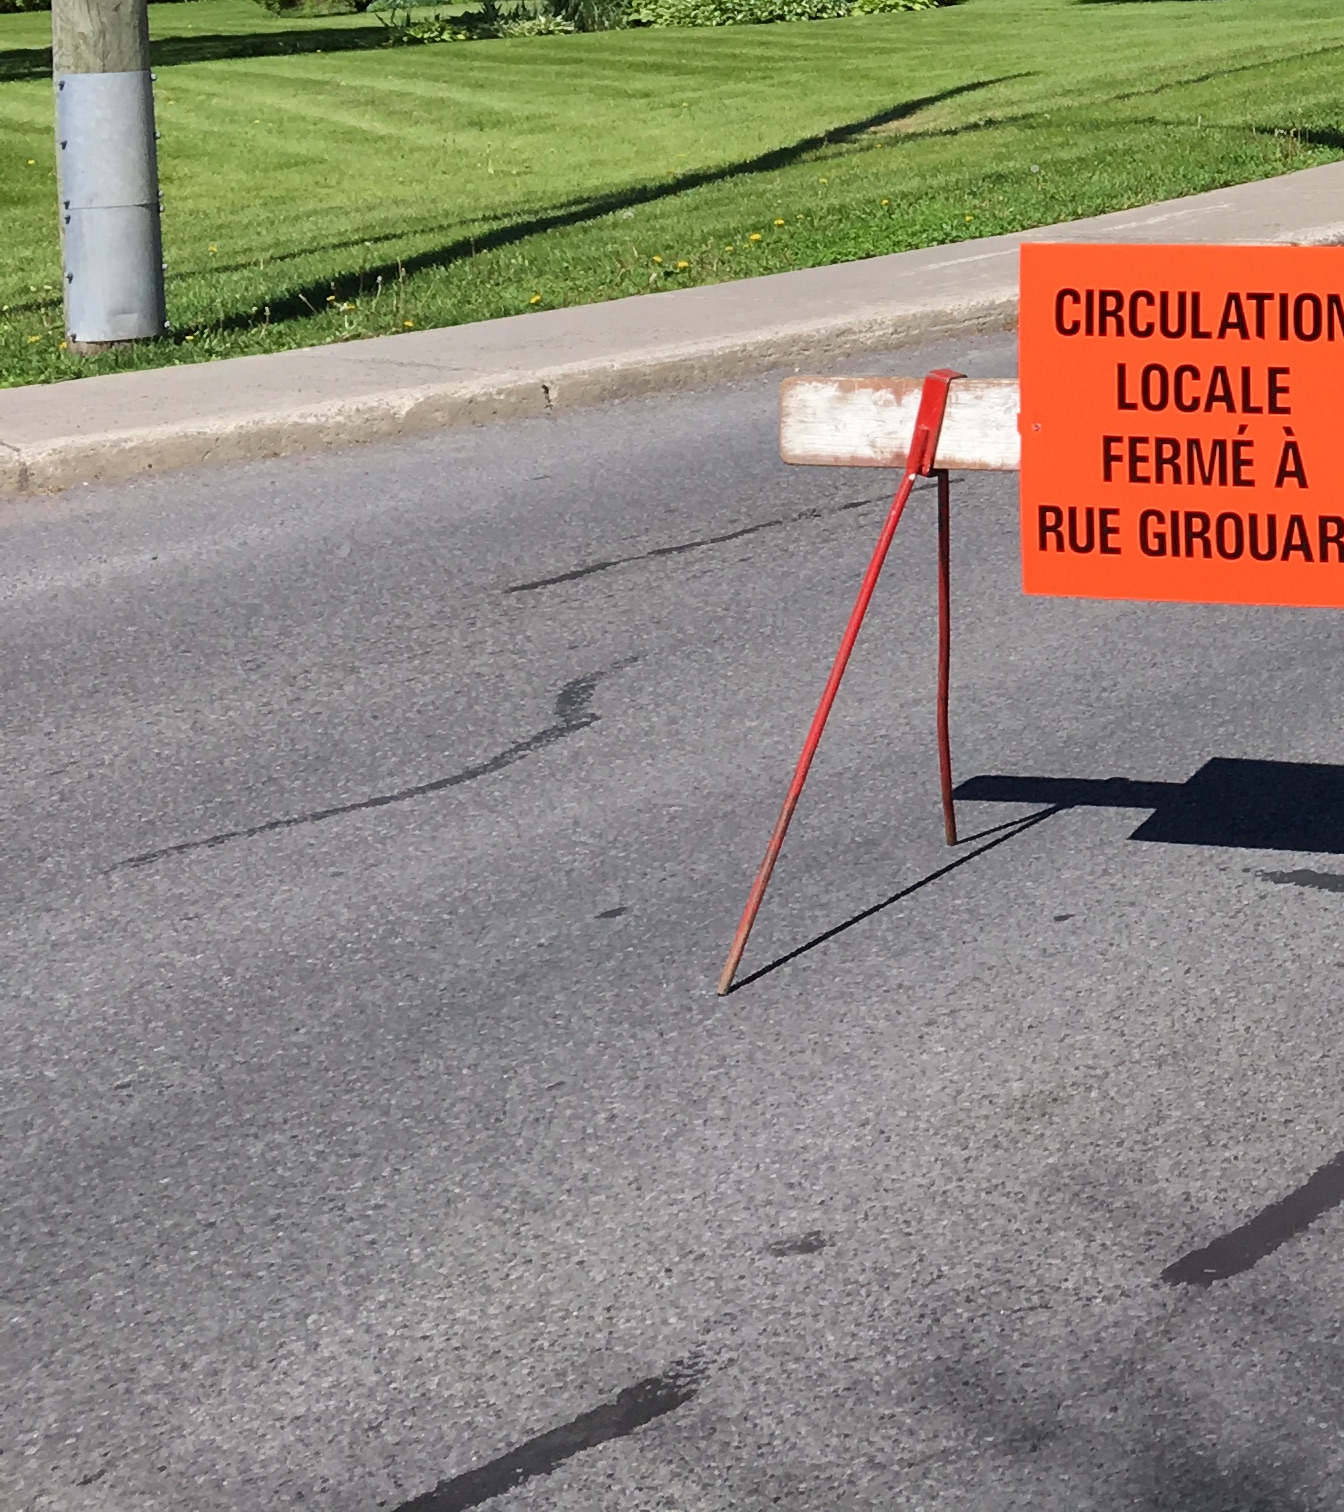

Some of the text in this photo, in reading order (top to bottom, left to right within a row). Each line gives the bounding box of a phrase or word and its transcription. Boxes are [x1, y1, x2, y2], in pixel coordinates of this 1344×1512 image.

[1118, 363, 1291, 414] LOCALE
[1103, 424, 1308, 489] FERMÉ À
[1038, 505, 1121, 555] RUE
